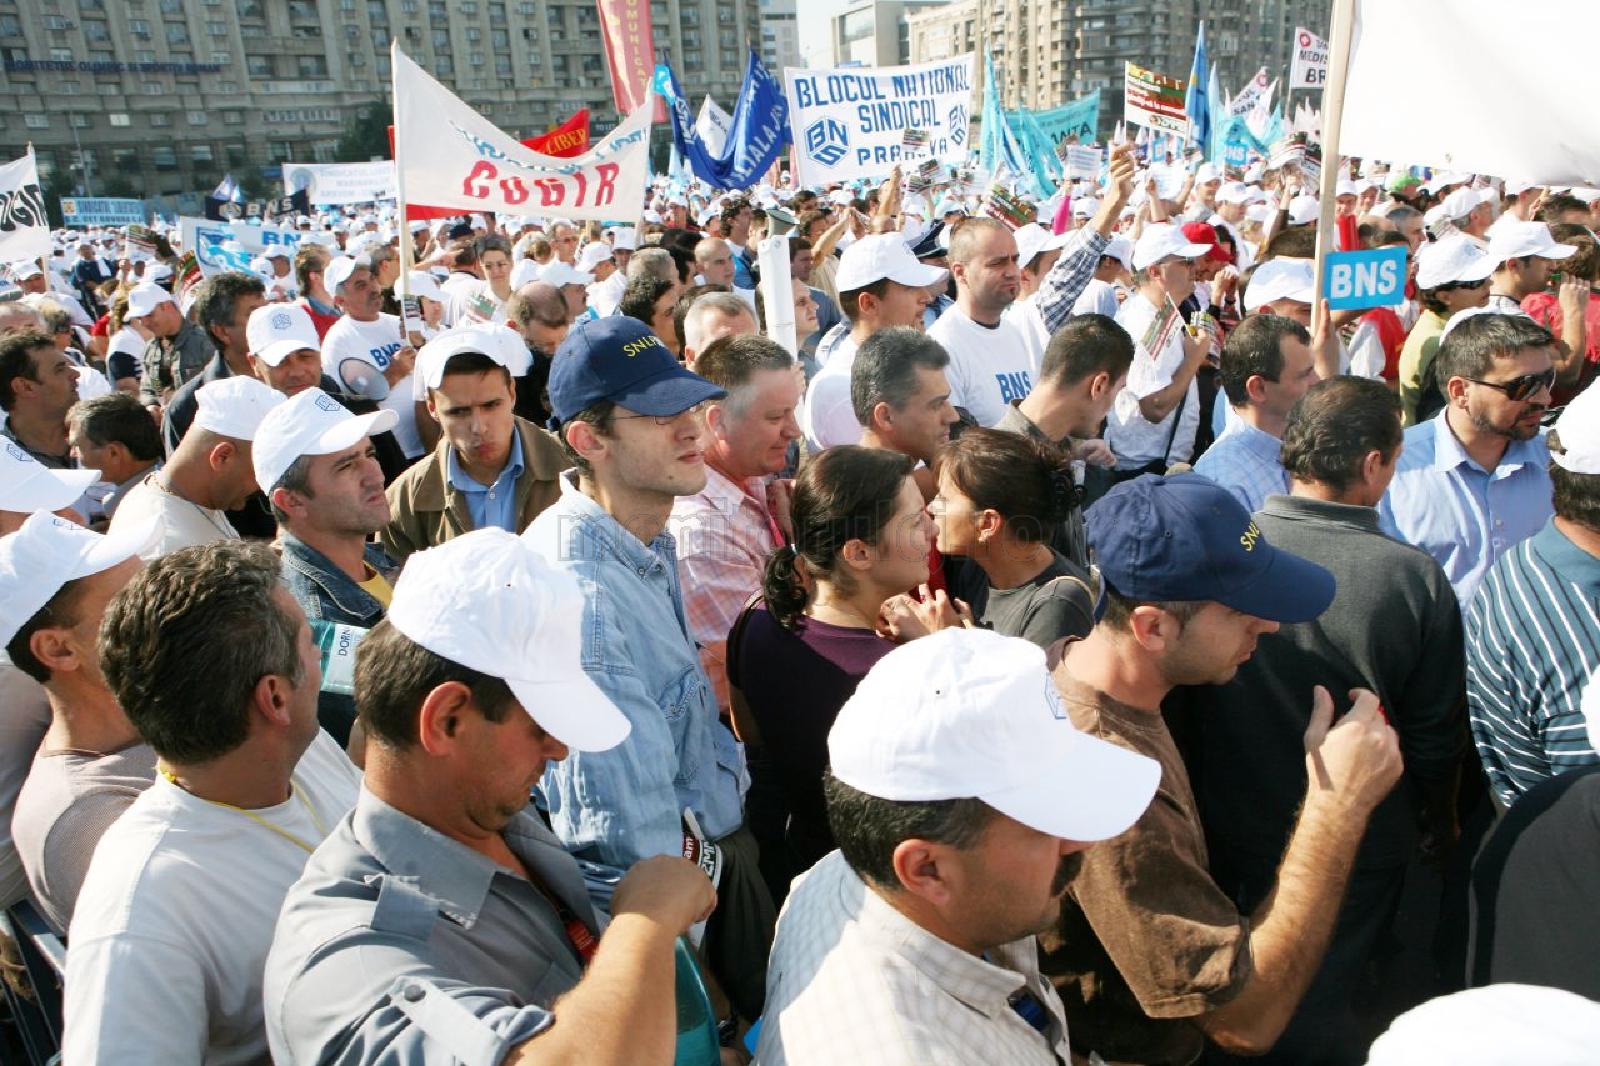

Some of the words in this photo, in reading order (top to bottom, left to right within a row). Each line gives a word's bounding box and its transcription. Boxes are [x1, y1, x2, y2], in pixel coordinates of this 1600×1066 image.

[794, 75, 886, 110] BLOCUL
[891, 64, 970, 98] NATIONAL
[858, 99, 941, 134] SINDICAL
[856, 138, 948, 166] PRAVA
[1331, 259, 1397, 298] BNS
[995, 370, 1032, 405] BNS
